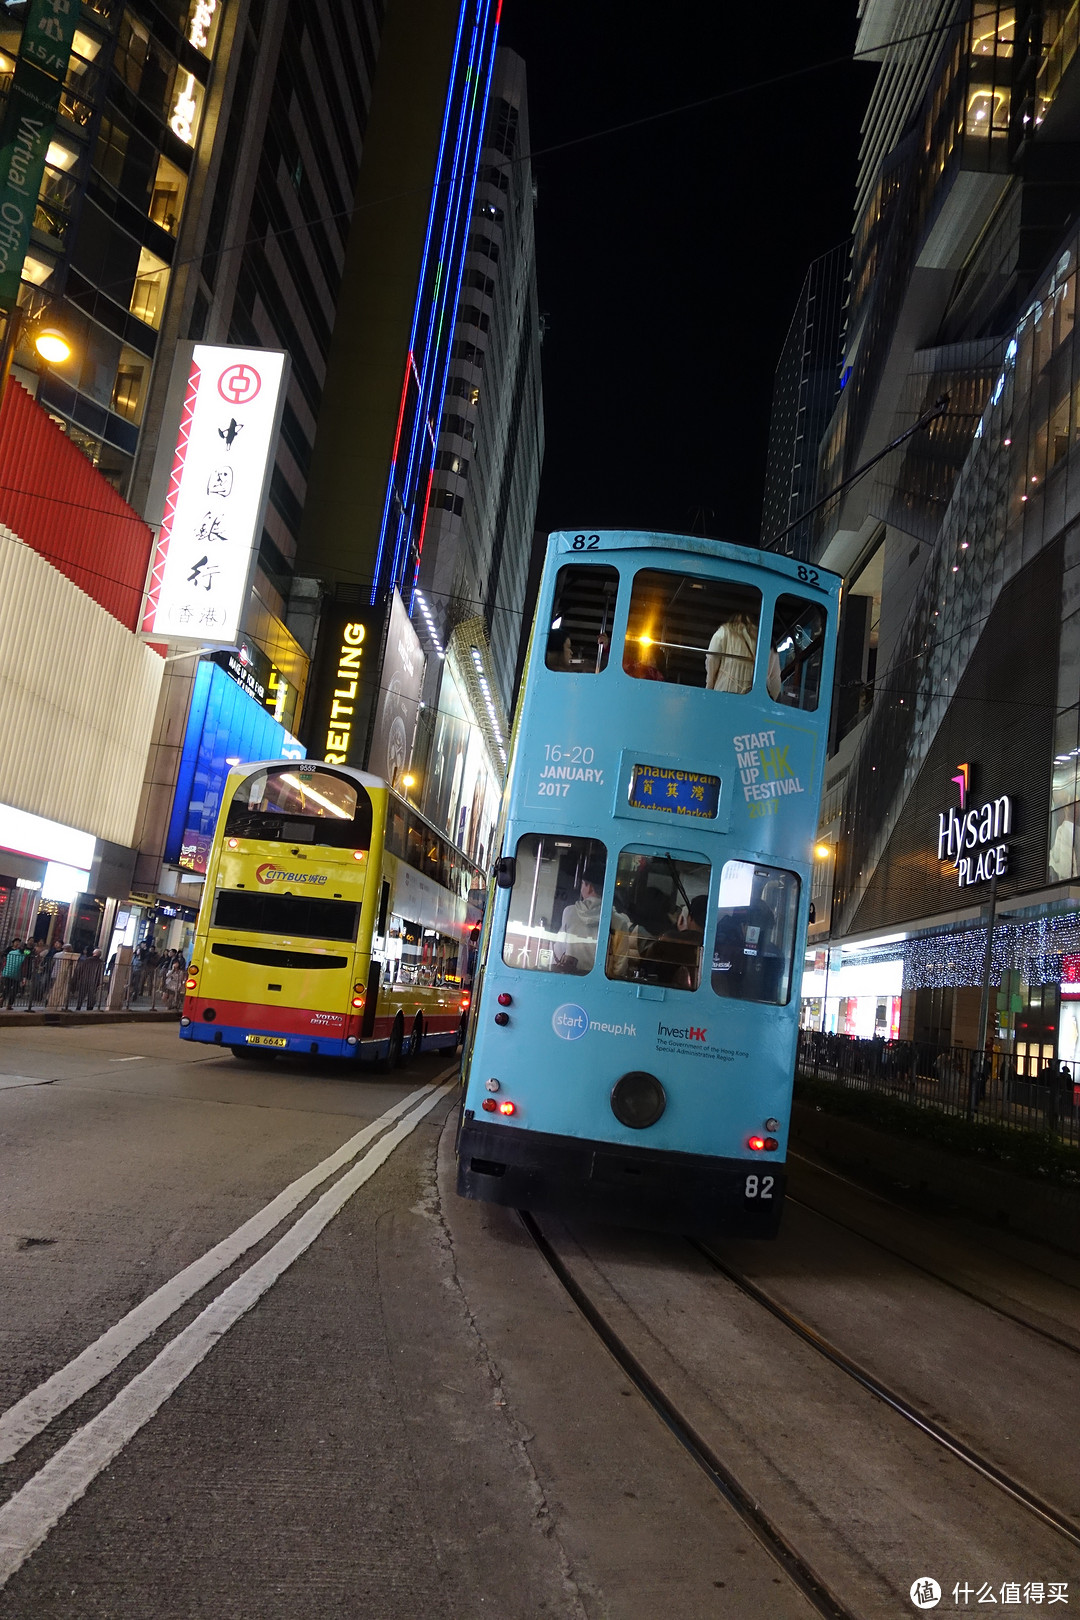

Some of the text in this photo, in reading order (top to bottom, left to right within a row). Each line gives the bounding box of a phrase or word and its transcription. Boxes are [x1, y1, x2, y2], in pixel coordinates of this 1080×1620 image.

[26, 41, 65, 70] 15/F
[7, 116, 44, 196] Virtual
[187, 417, 244, 592] 中國銀行
[572, 534, 600, 550] 82
[797, 565, 820, 587] 82
[733, 730, 776, 752] START
[544, 744, 594, 765] 16-20
[737, 744, 795, 781] ME HK
[540, 765, 604, 785] JANUARY,
[740, 767, 760, 786] UP
[537, 782, 570, 797] 2017
[643, 779, 705, 802] 筲箕灣
[743, 777, 805, 802] FESTIVAL
[747, 798, 780, 819] 2017
[938, 795, 1010, 867] Hysan
[266, 870, 309, 883] CITYBUS
[958, 844, 1007, 887] PLACE
[315, 1013, 343, 1022] VOLVO
[263, 1036, 284, 1047] 6643
[657, 1021, 708, 1043] InvestHK
[655, 1044, 735, 1063] Special Administrative Region
[657, 1038, 667, 1046] The
[668, 1039, 703, 1050] Government
[710, 1045, 720, 1053] the
[720, 1047, 735, 1057] Hong
[735, 1050, 749, 1059] Kong
[745, 1174, 774, 1199] 82
